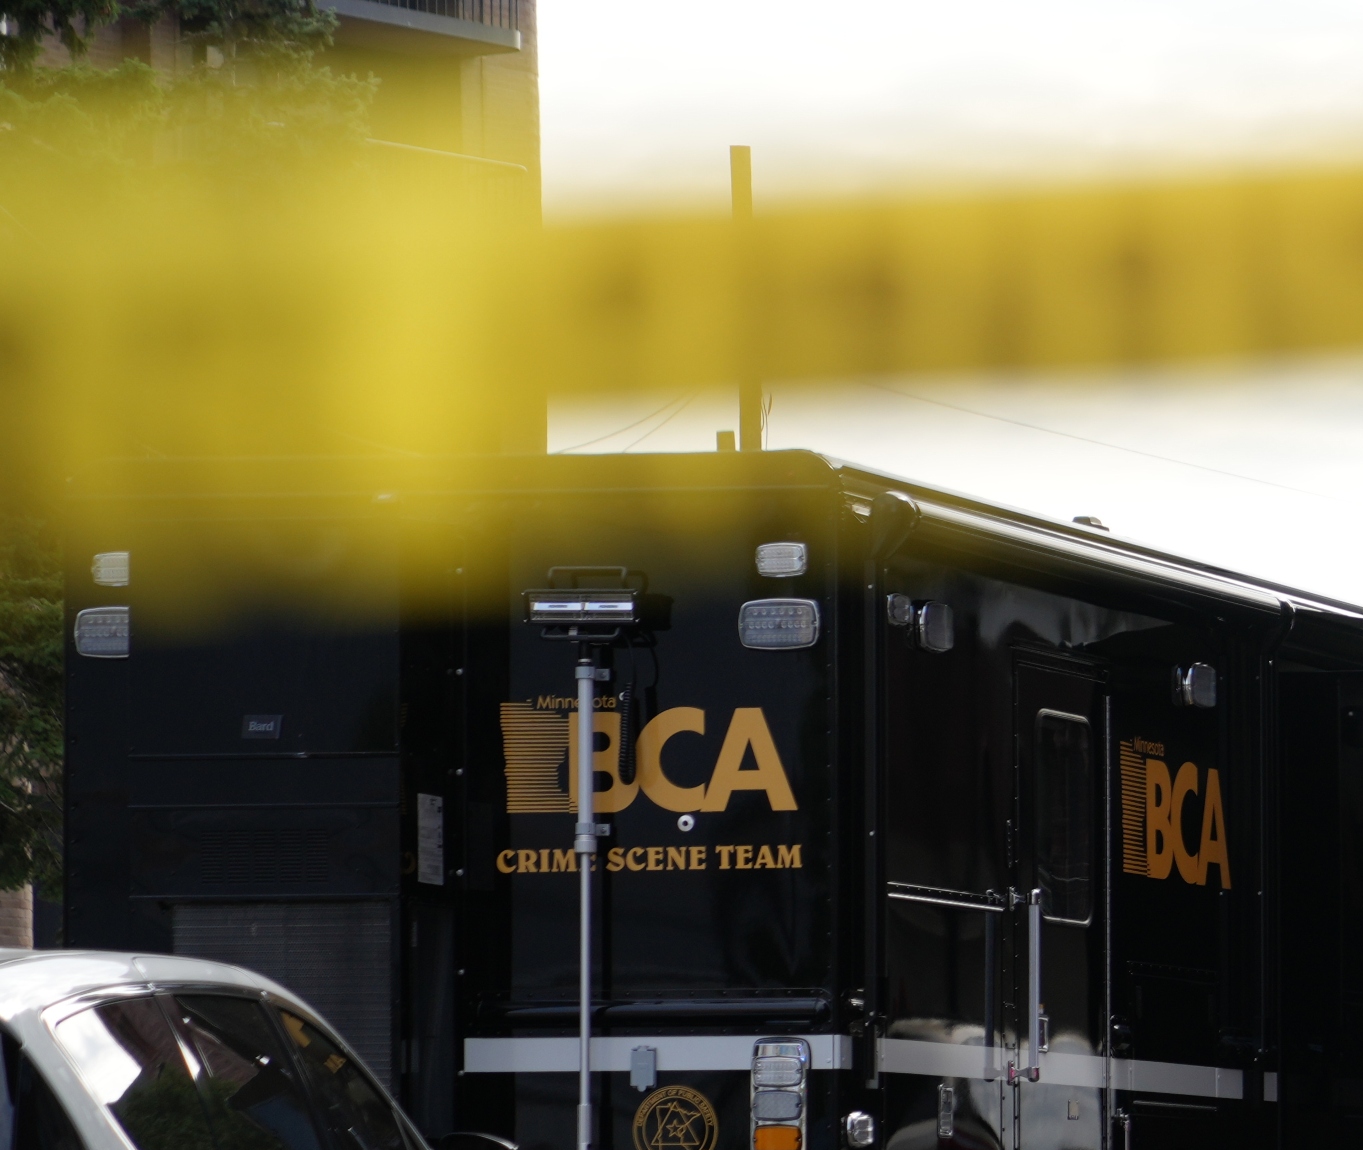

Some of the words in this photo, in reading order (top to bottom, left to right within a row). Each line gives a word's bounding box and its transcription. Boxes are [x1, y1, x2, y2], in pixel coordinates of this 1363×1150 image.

[536, 695, 617, 710] Minneota
[248, 721, 274, 731] Bard
[1133, 736, 1165, 757] Minnesota
[568, 706, 798, 813] BCA
[1146, 758, 1231, 890] BCA
[606, 846, 707, 871] SCENE
[715, 844, 803, 870] TEAM
